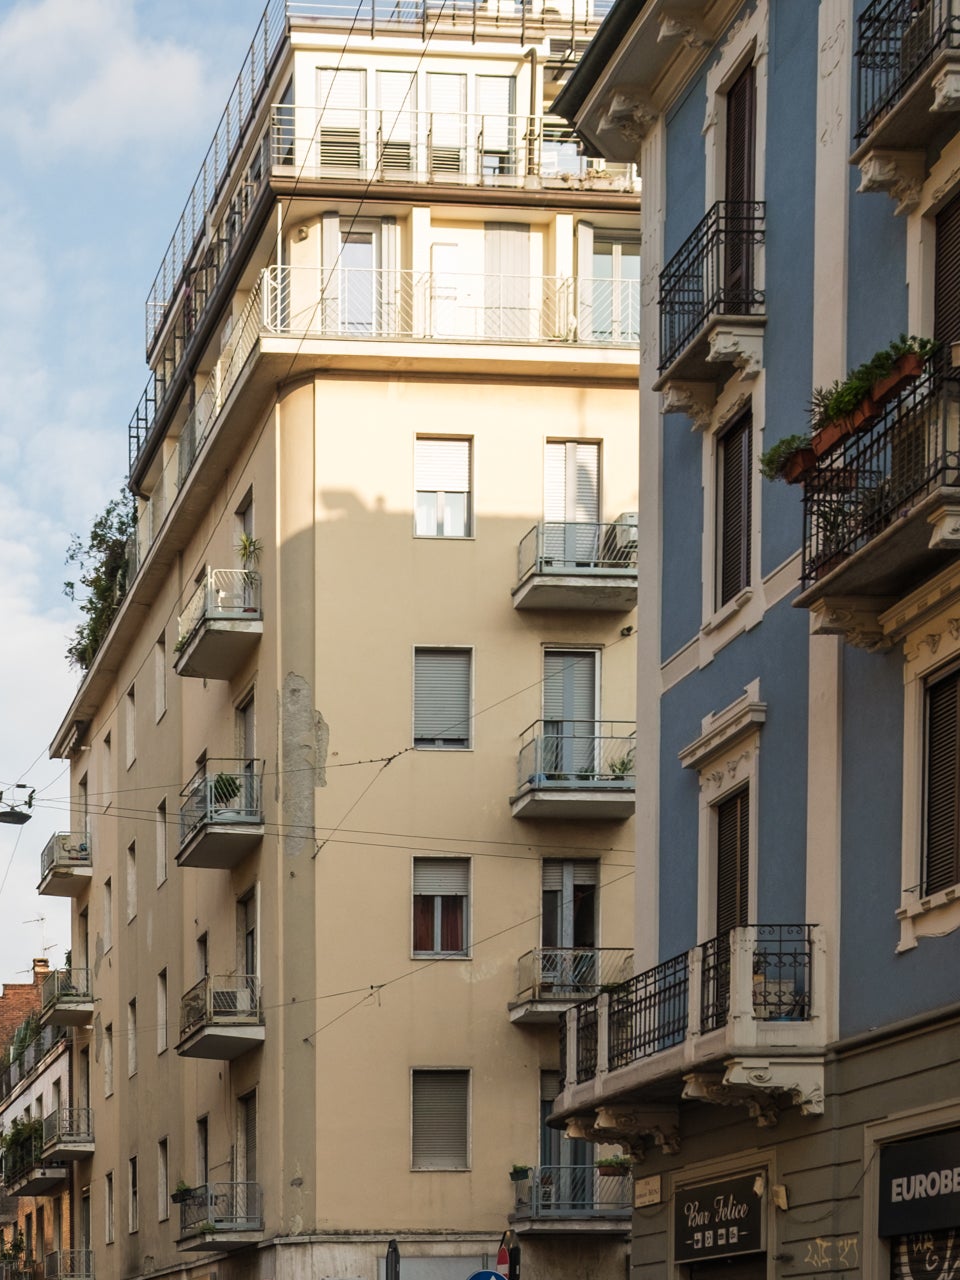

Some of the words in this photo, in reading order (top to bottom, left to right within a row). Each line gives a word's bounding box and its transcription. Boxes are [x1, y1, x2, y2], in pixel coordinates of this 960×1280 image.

[891, 1166, 960, 1203] EUROBE
[684, 1201, 711, 1228] Bar
[714, 1193, 749, 1223] Felice
